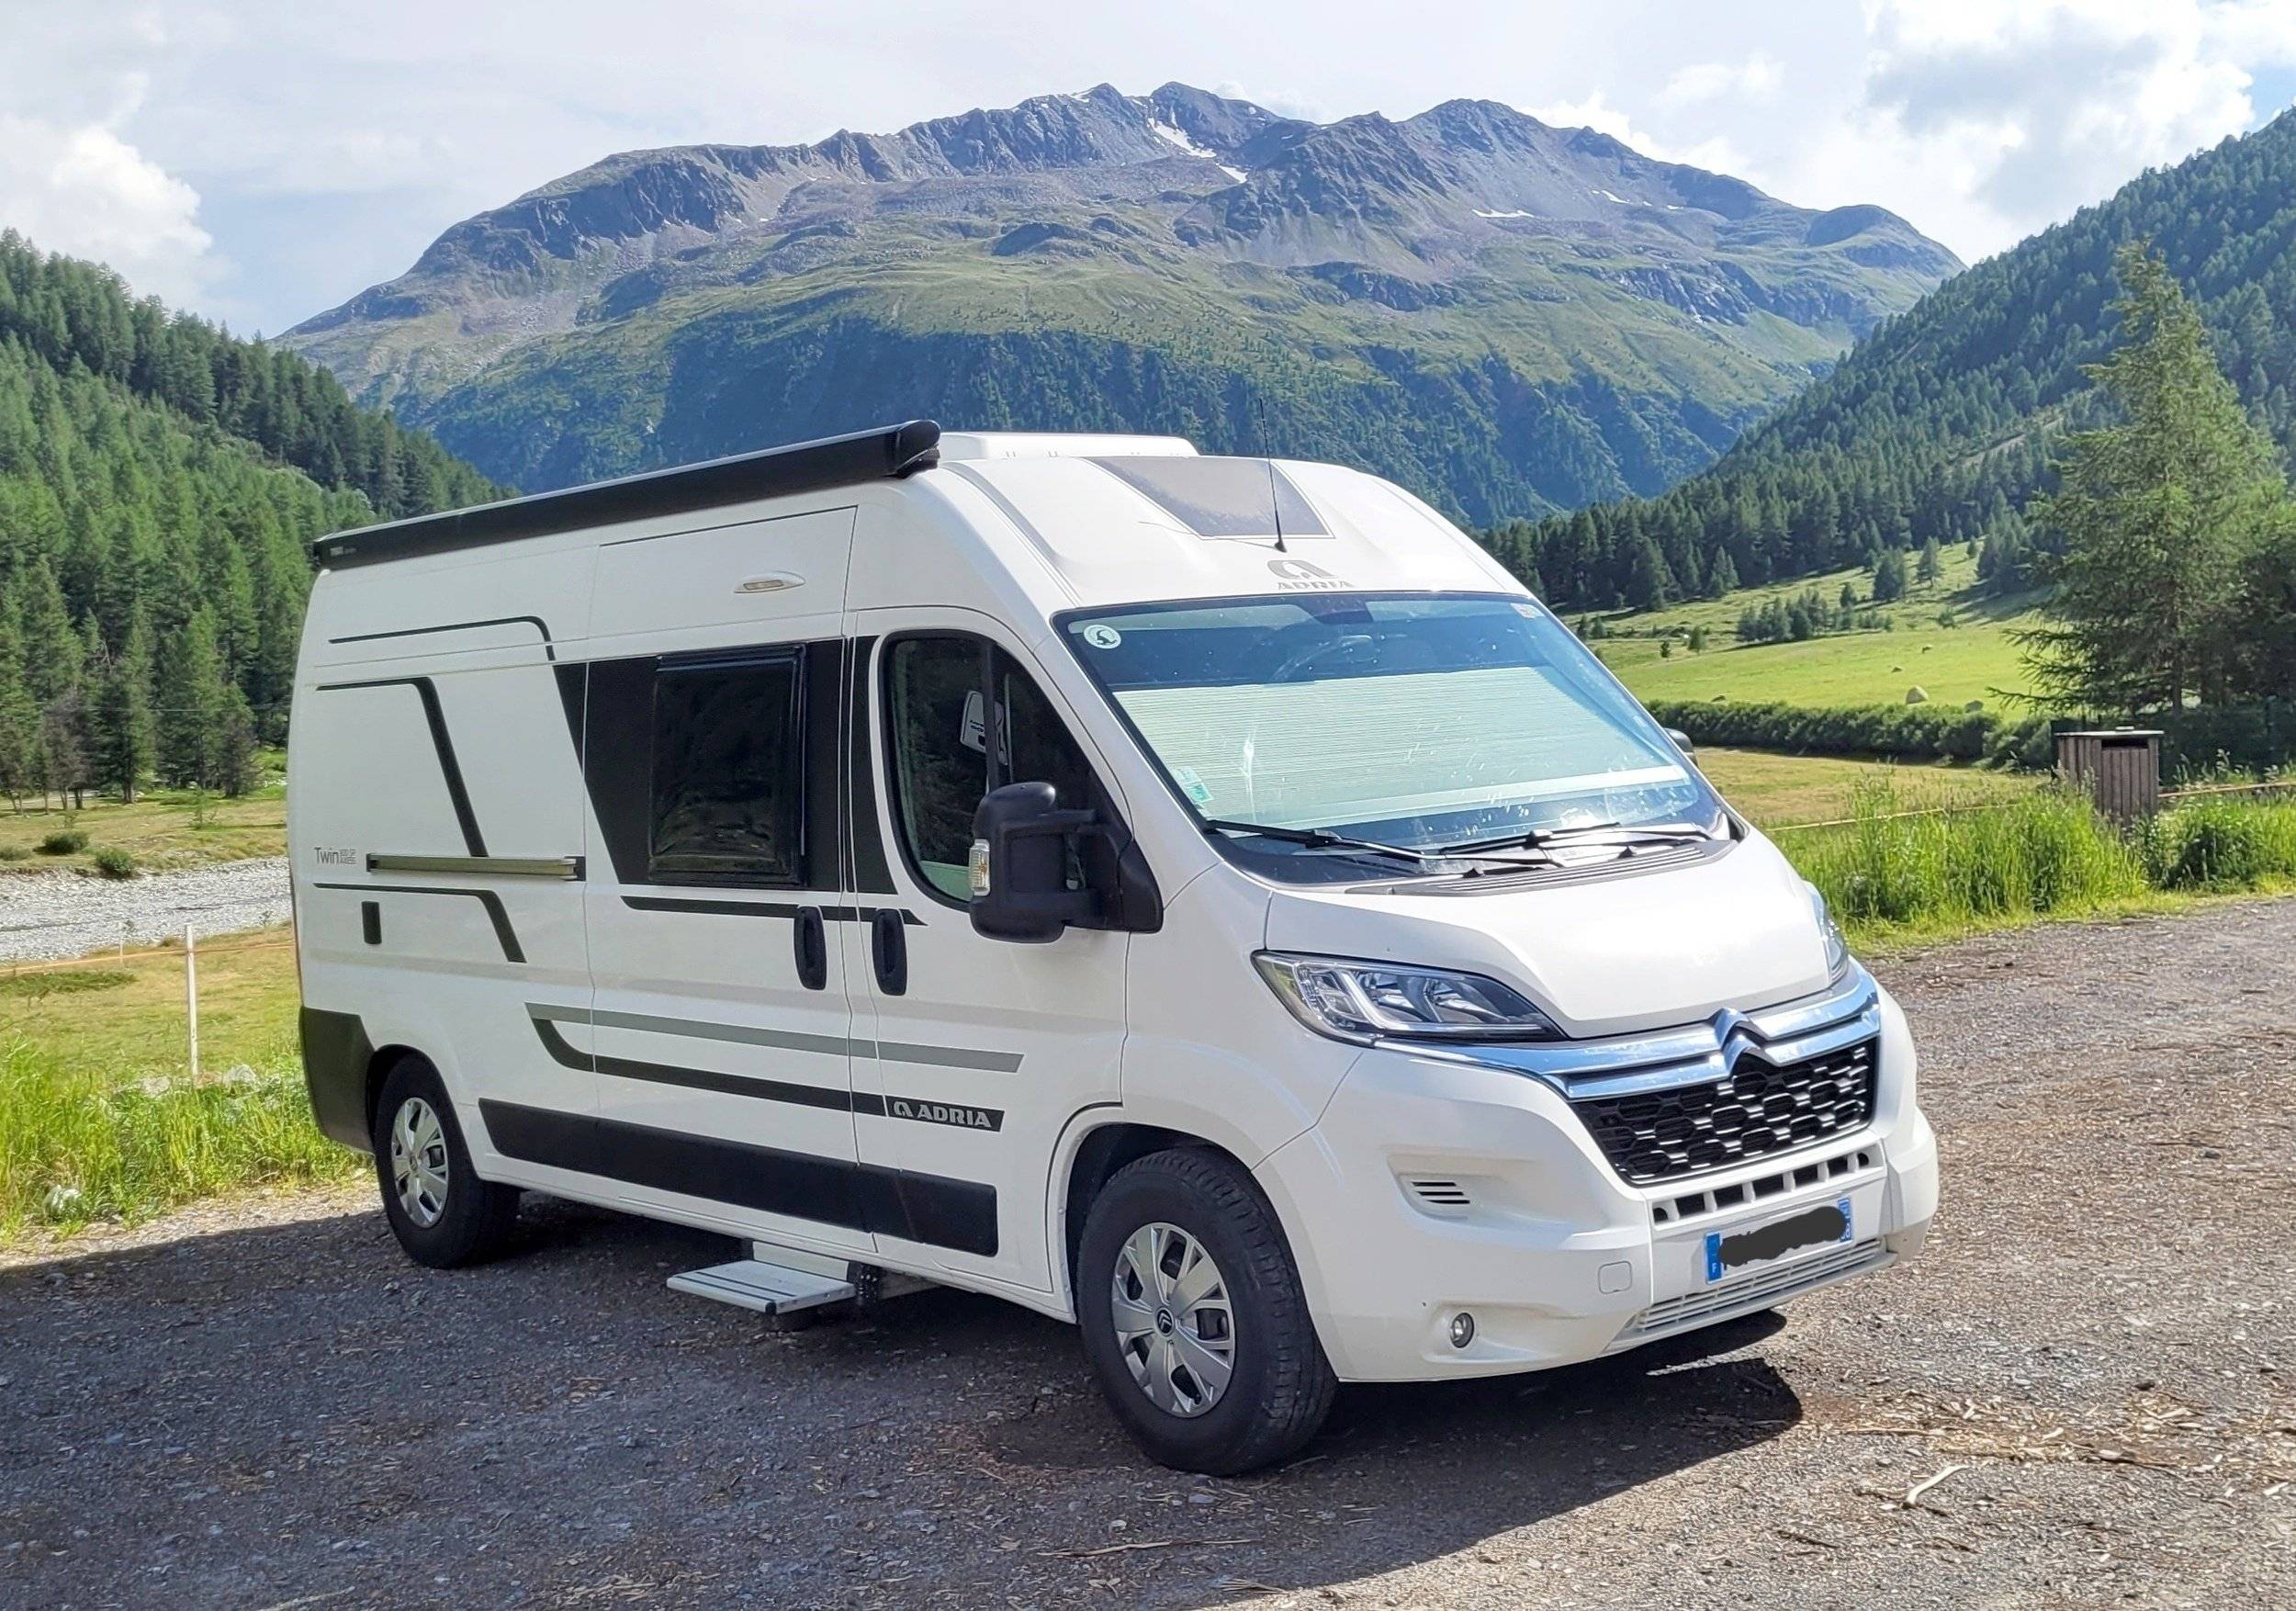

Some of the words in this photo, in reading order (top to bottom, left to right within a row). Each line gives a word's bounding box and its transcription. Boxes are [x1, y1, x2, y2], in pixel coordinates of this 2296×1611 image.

[1277, 580, 1356, 590] ADRIA
[313, 847, 339, 864] Twin
[917, 1104, 992, 1128] ADRIA
[1711, 1262, 1717, 1273] F
